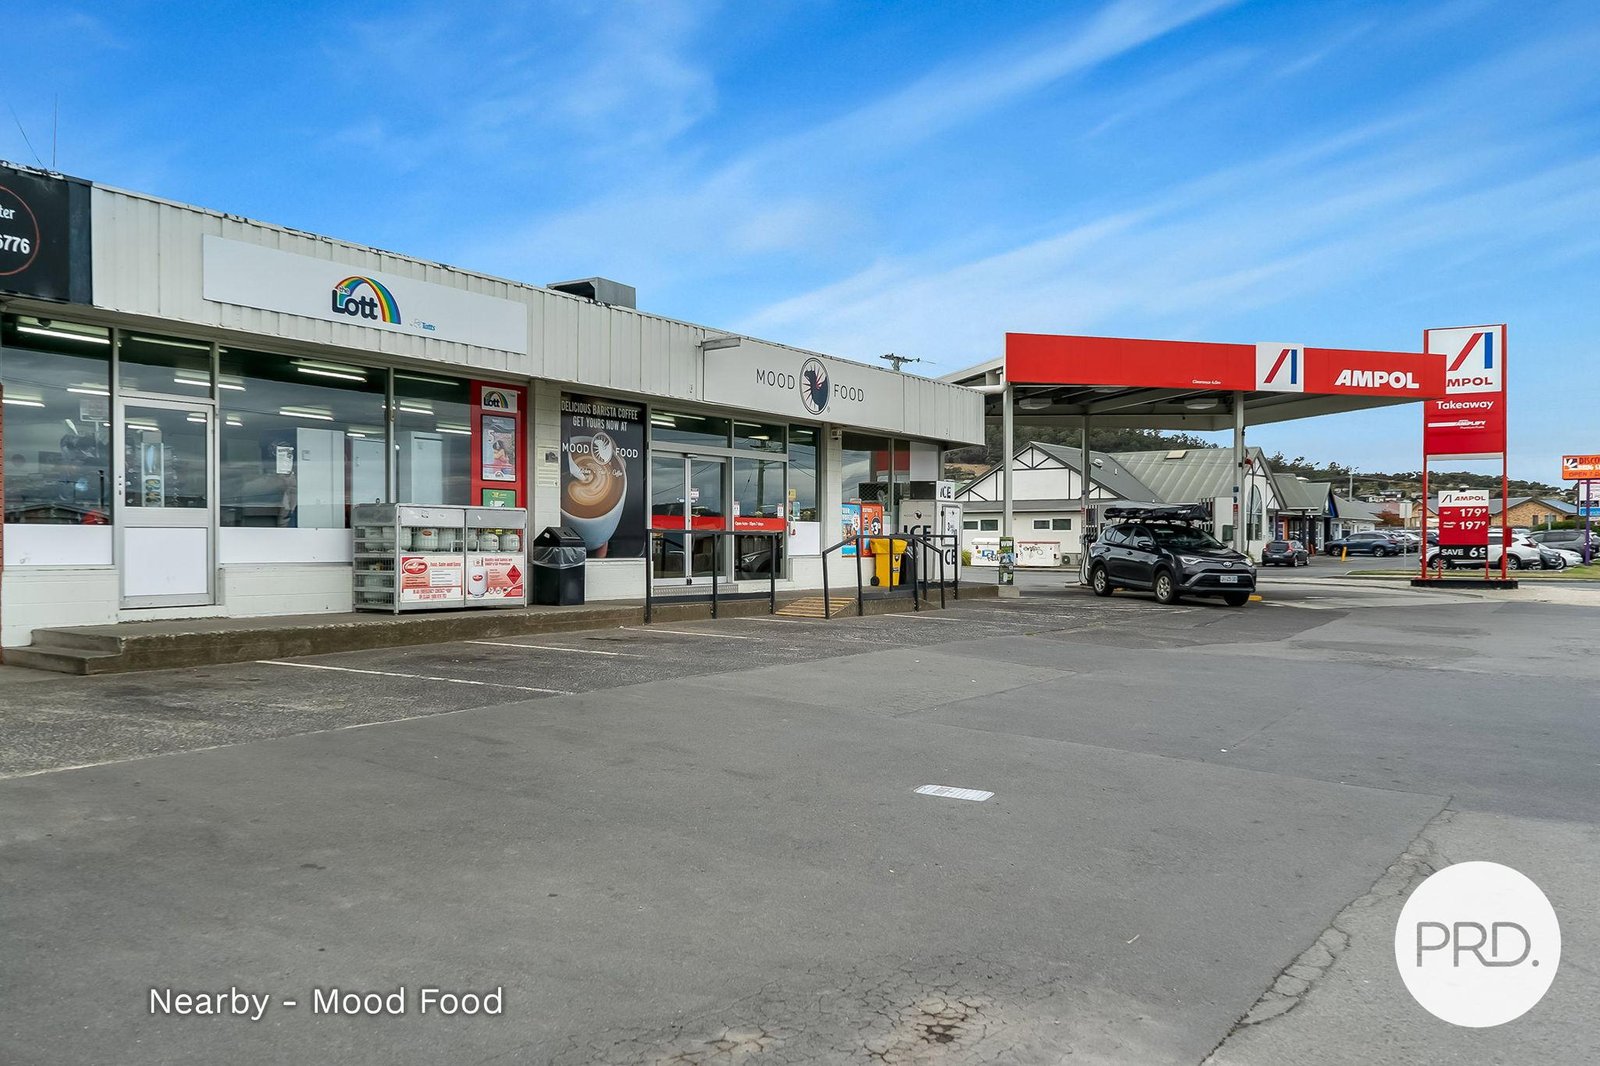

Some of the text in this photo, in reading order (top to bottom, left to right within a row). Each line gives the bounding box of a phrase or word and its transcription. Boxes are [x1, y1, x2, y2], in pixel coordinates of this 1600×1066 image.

[332, 289, 378, 320] Lott
[756, 368, 865, 402] MOOD FOOD
[1334, 369, 1420, 389] AMPOL
[1446, 376, 1494, 388] MPOL
[561, 400, 639, 420] DELICIOUS BARISTA COFFEE
[1436, 400, 1495, 411] Takeaway
[572, 416, 628, 432] GET YOURS NOW AT
[561, 442, 639, 458] MOOD FOOD
[939, 486, 952, 499] ICE
[1441, 548, 1464, 556] SAVE
